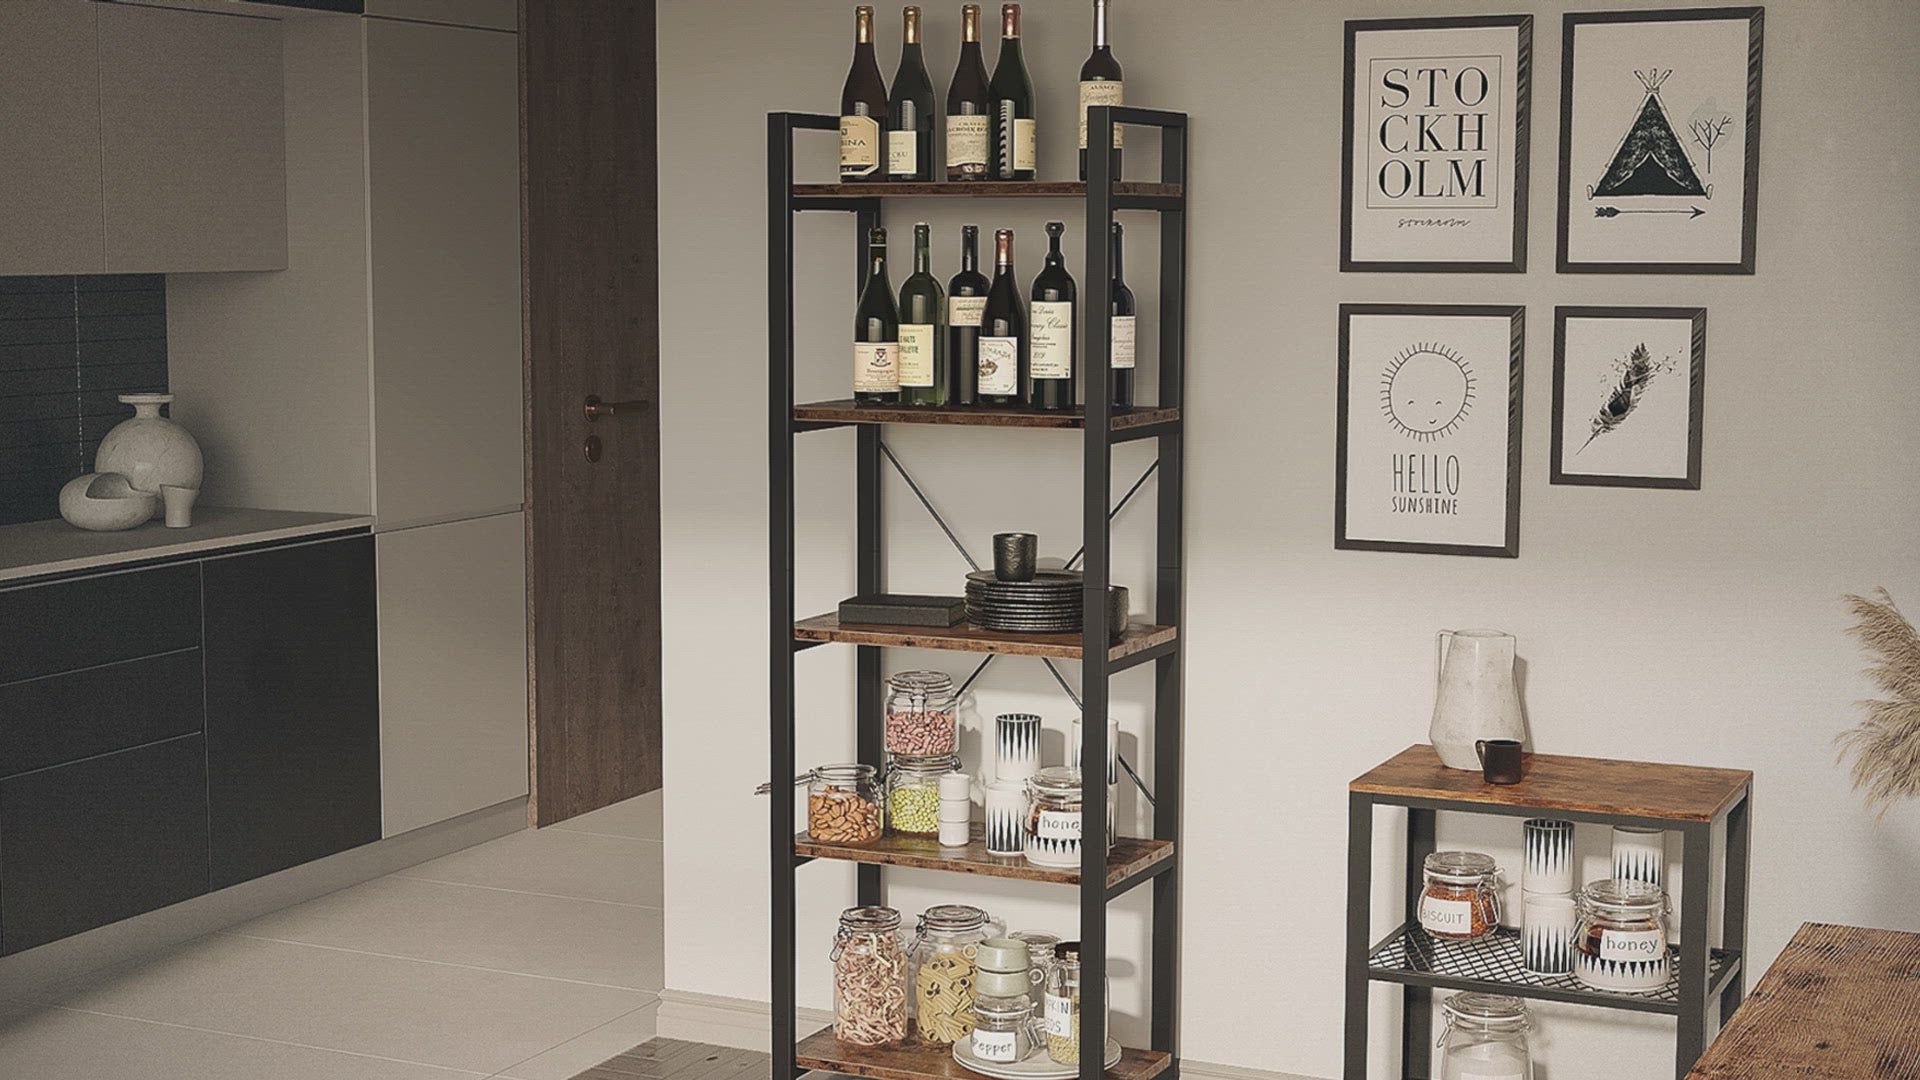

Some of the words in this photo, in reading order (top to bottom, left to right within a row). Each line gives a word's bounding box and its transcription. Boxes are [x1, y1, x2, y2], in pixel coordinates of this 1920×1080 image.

[1381, 67, 1488, 108] STO
[1380, 113, 1488, 153] CKH
[1379, 159, 1487, 198] OLM
[1393, 454, 1460, 496] HELLO
[1392, 496, 1458, 515] SUNSHINE
[1042, 815, 1082, 832] hone
[1422, 909, 1465, 924] BISCUIT
[1606, 935, 1658, 954] honey
